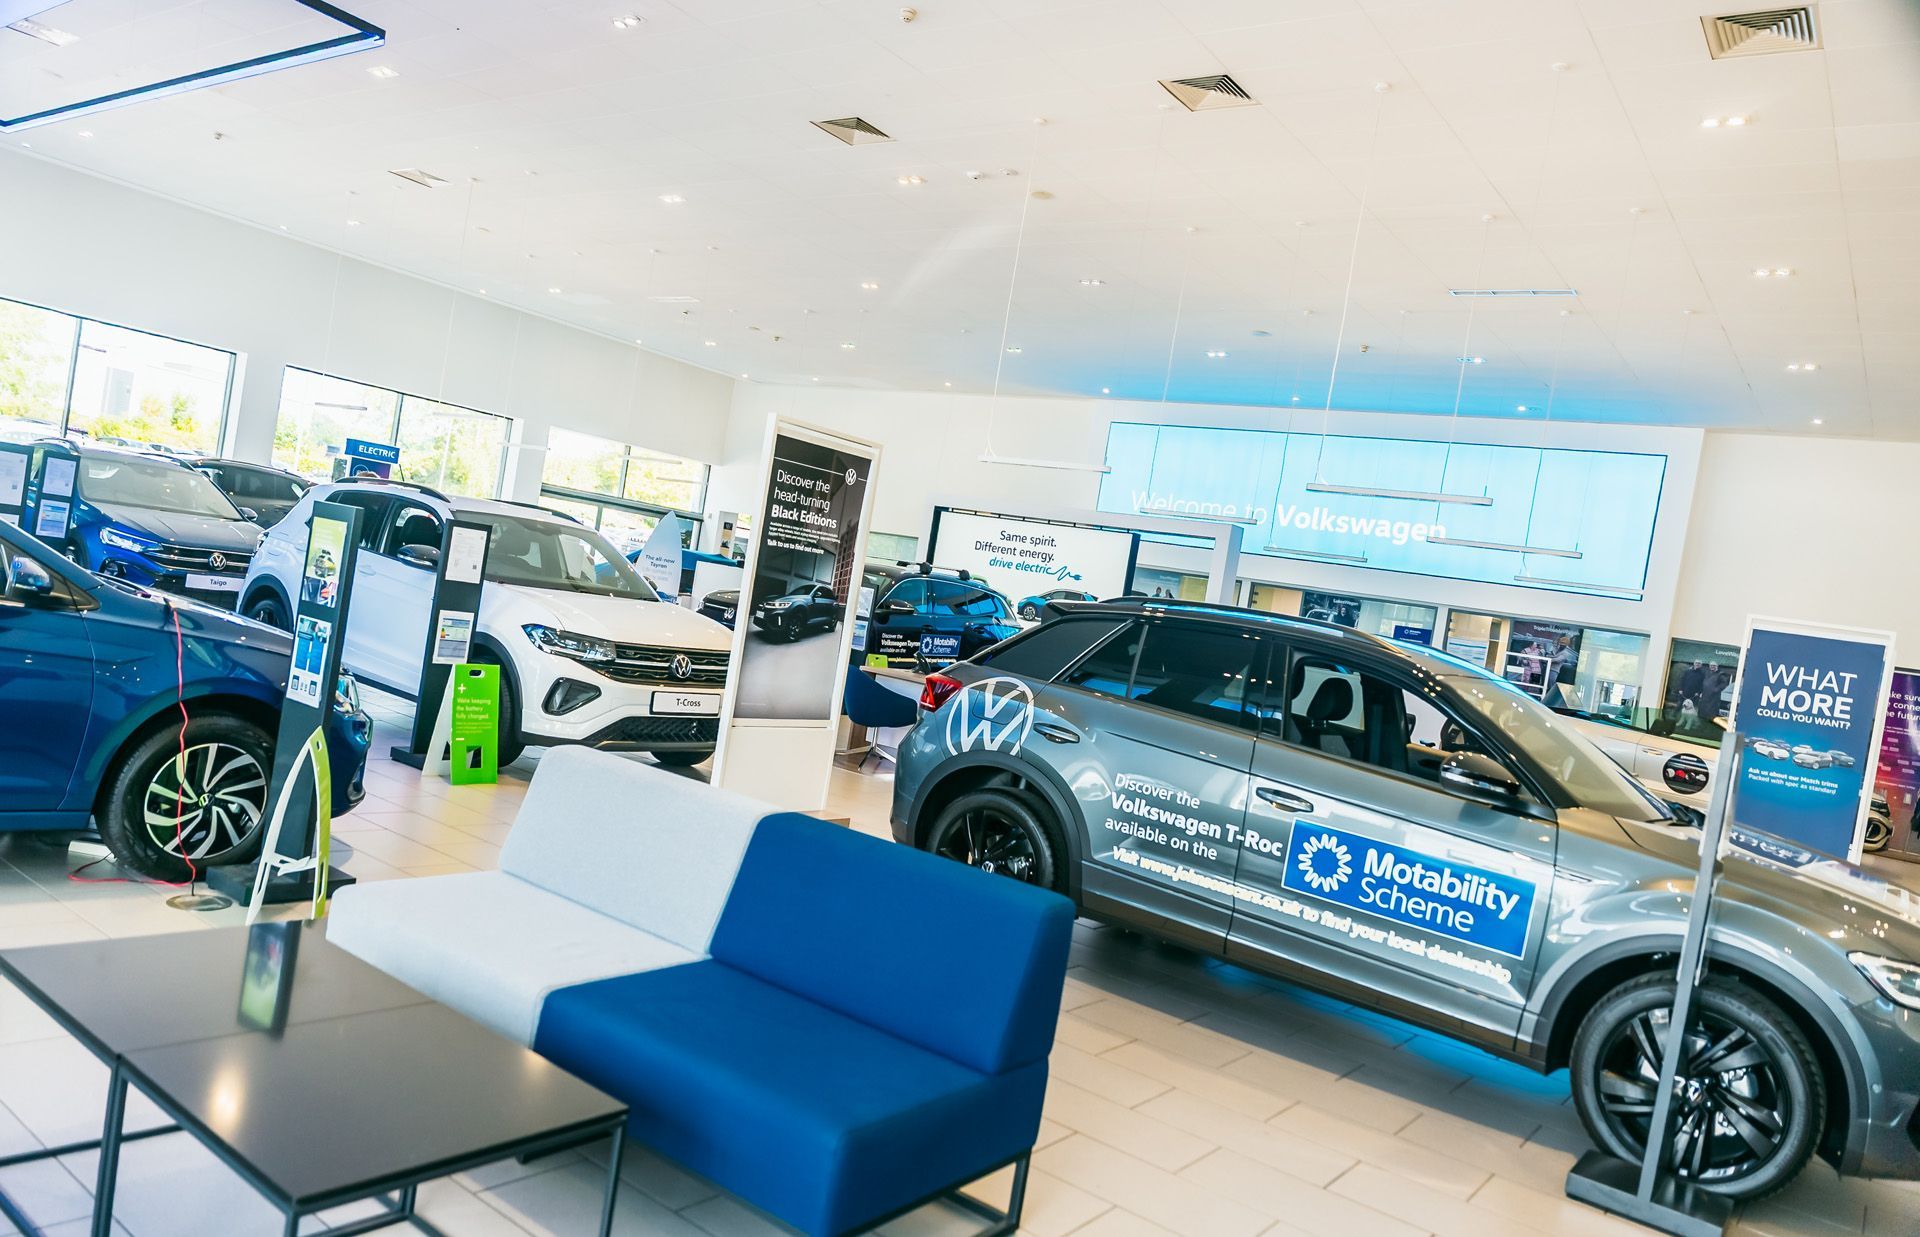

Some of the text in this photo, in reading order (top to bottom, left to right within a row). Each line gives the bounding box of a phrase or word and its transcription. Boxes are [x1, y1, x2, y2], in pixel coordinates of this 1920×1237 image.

[358, 444, 396, 459] ELECTRIC
[776, 469, 831, 493] Discover the
[773, 486, 831, 513] head-turning
[771, 504, 838, 529] Black Editions
[1131, 490, 1447, 546] Welcome to Volkswagen
[767, 539, 778, 547] Talk
[794, 543, 804, 551] find
[812, 547, 825, 555] more
[999, 530, 1057, 548] Same spirit.
[974, 540, 1055, 563] Different energy.
[989, 557, 1051, 575] drive electric
[210, 579, 227, 587] Taigo
[881, 639, 907, 648] Volkswagen
[932, 646, 952, 654] Scheme
[933, 637, 958, 648] Motability
[1766, 662, 1858, 695] WHAT
[676, 698, 701, 707] T-Cross
[1760, 685, 1854, 720] MORE
[1756, 708, 1851, 730] COULD YOU WANT?
[1748, 767, 1760, 775] Ask
[1768, 770, 1788, 780] about
[1788, 774, 1800, 782] our
[1800, 775, 1820, 785] Match
[1820, 779, 1838, 789] trims
[1748, 773, 1837, 795] Packed with spec as standard
[1114, 773, 1200, 809] Discover the
[1111, 791, 1284, 857] Volkswagen T-Roc
[1104, 817, 1218, 861] available on the
[1363, 847, 1521, 921] Motability
[1112, 845, 1139, 866] Visit
[1302, 905, 1320, 923] to
[1320, 910, 1352, 933] find
[1348, 922, 1389, 943] your
[1387, 930, 1427, 957] local
[1426, 944, 1512, 985] dealership
[1358, 876, 1475, 933] Scheme
